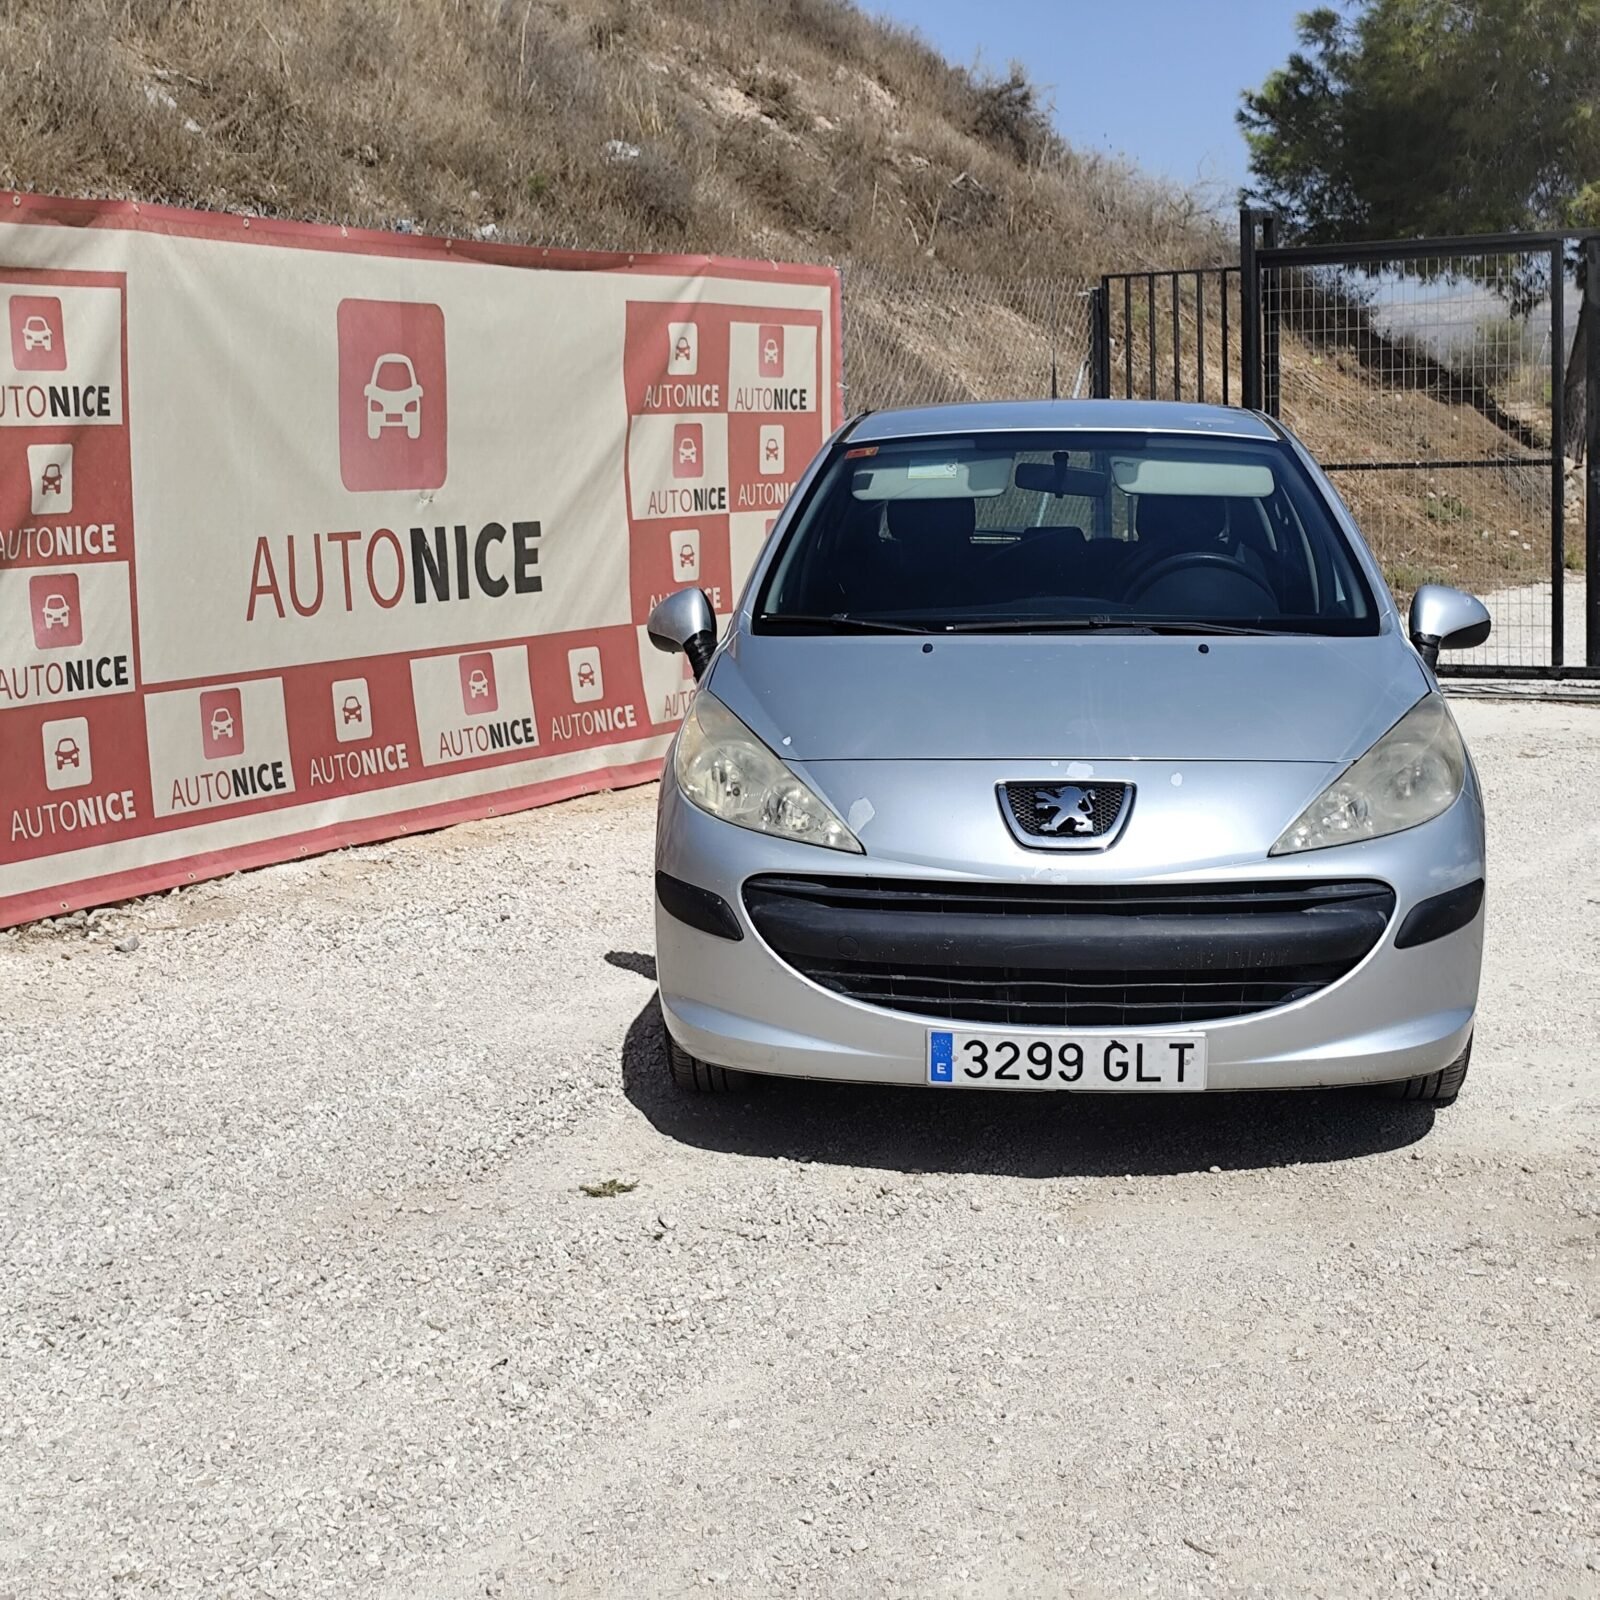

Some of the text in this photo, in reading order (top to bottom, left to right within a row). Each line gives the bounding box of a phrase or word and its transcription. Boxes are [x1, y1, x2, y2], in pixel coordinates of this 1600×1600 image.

[644, 384, 720, 409] AUTONICE
[735, 388, 807, 411] AUTONICE
[648, 487, 726, 515] AUTONICE
[246, 521, 543, 622] AUTONICE
[0, 655, 128, 700] AUTONICE
[439, 717, 535, 759] AUTONICE
[552, 705, 637, 742] AUTONICE
[171, 761, 286, 810] AUTONICE
[310, 743, 409, 786] AUTONICE
[11, 790, 136, 842] AUTONICE
[936, 1062, 947, 1074] E
[963, 1039, 1195, 1083] 3299 GLT
